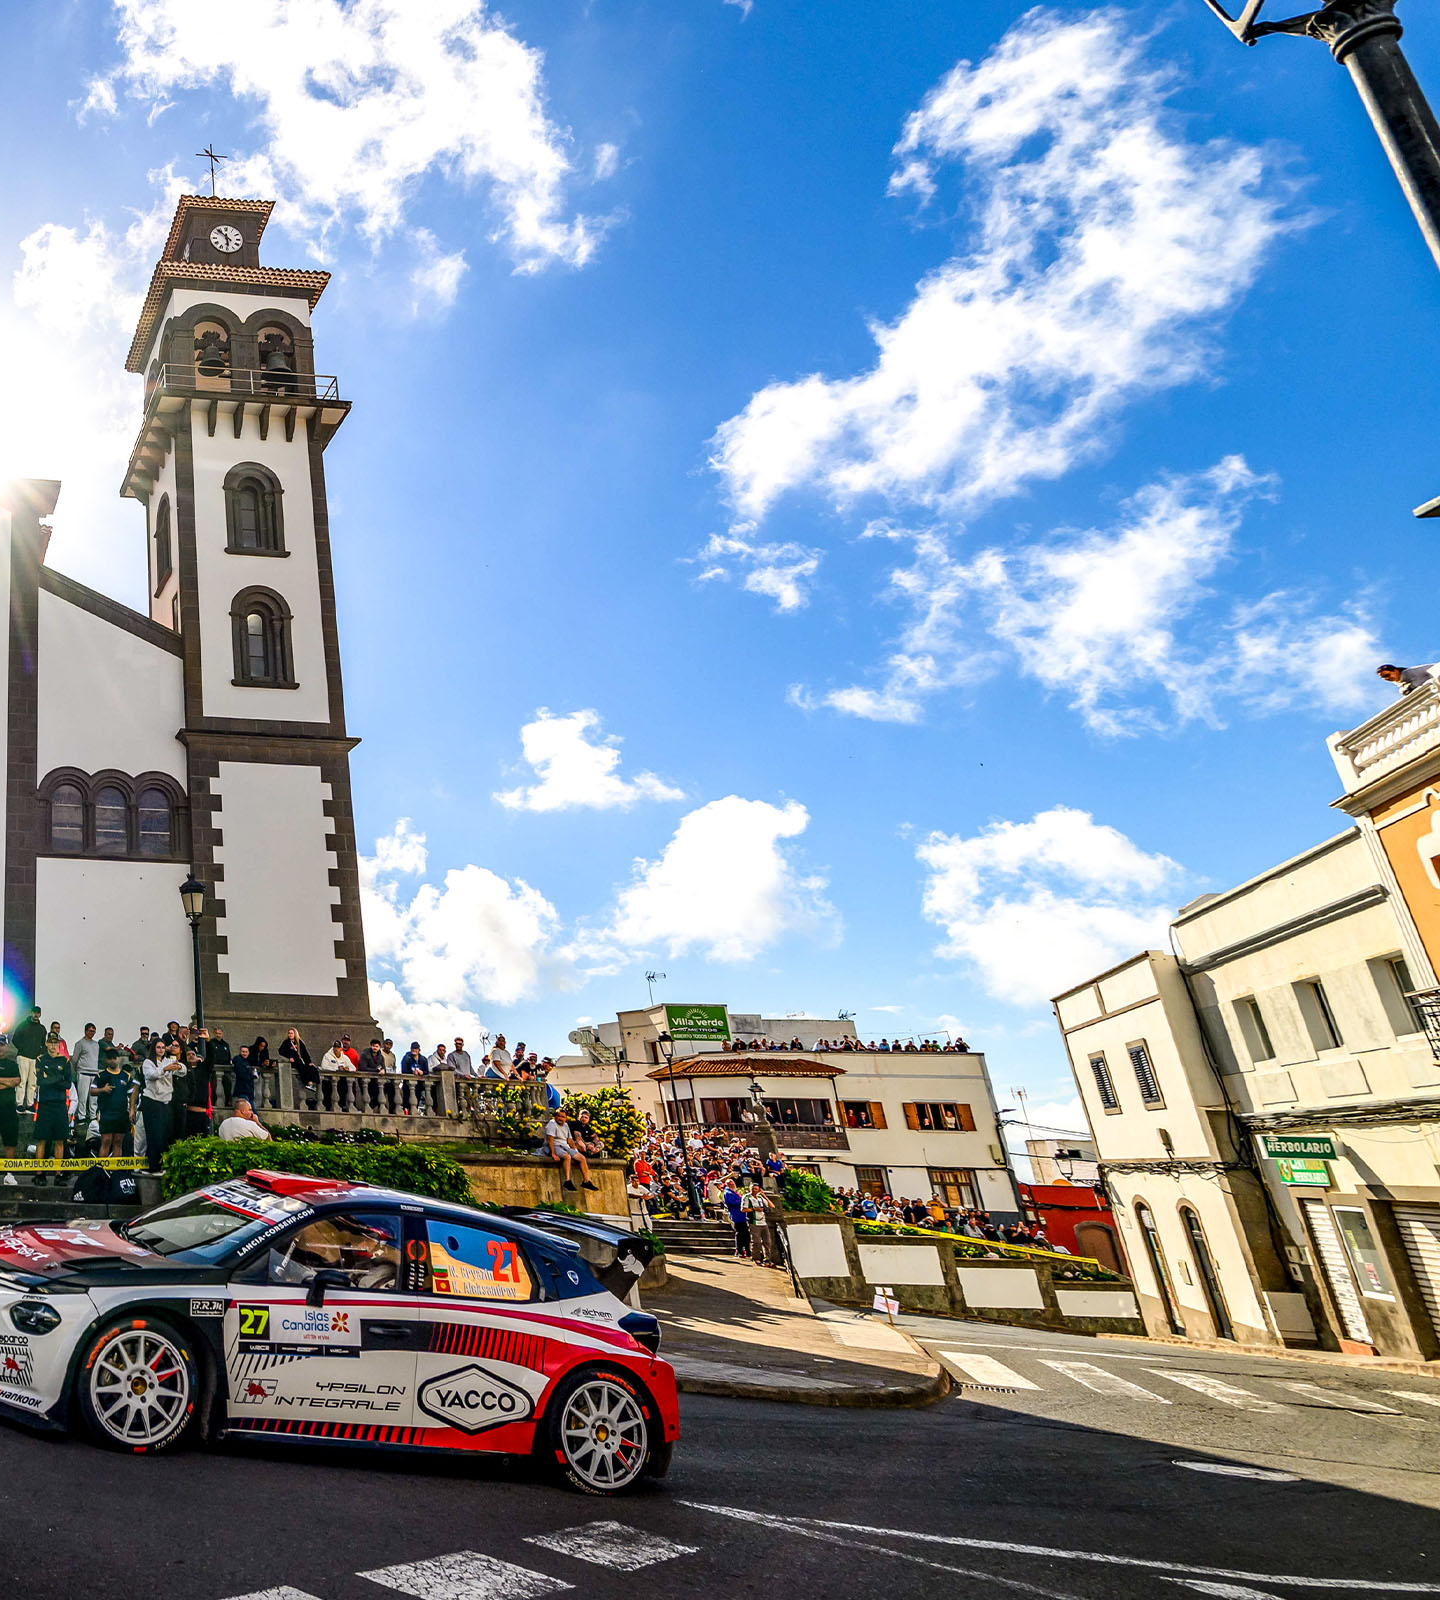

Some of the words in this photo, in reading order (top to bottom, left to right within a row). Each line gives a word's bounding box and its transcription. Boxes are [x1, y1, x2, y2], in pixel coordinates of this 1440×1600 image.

[672, 1018, 694, 1026] Villa
[1267, 1142, 1331, 1153] HERBOLARIO
[4, 1160, 23, 1168] ZONA
[24, 1160, 54, 1168] PUBLICO
[60, 1160, 79, 1168] ZONA
[116, 1159, 134, 1167] ZONA
[486, 1240, 520, 1283] 27
[461, 1266, 494, 1281] Gryazin
[464, 1282, 517, 1298] Aleksandrov
[240, 1308, 269, 1335] 27
[305, 1310, 329, 1321] Islas
[282, 1319, 329, 1331] Canarias
[0, 1335, 28, 1345] sparco
[316, 1382, 406, 1395] YPSILON
[275, 1396, 401, 1411] INTEGRALE
[435, 1389, 515, 1412] YACCO
